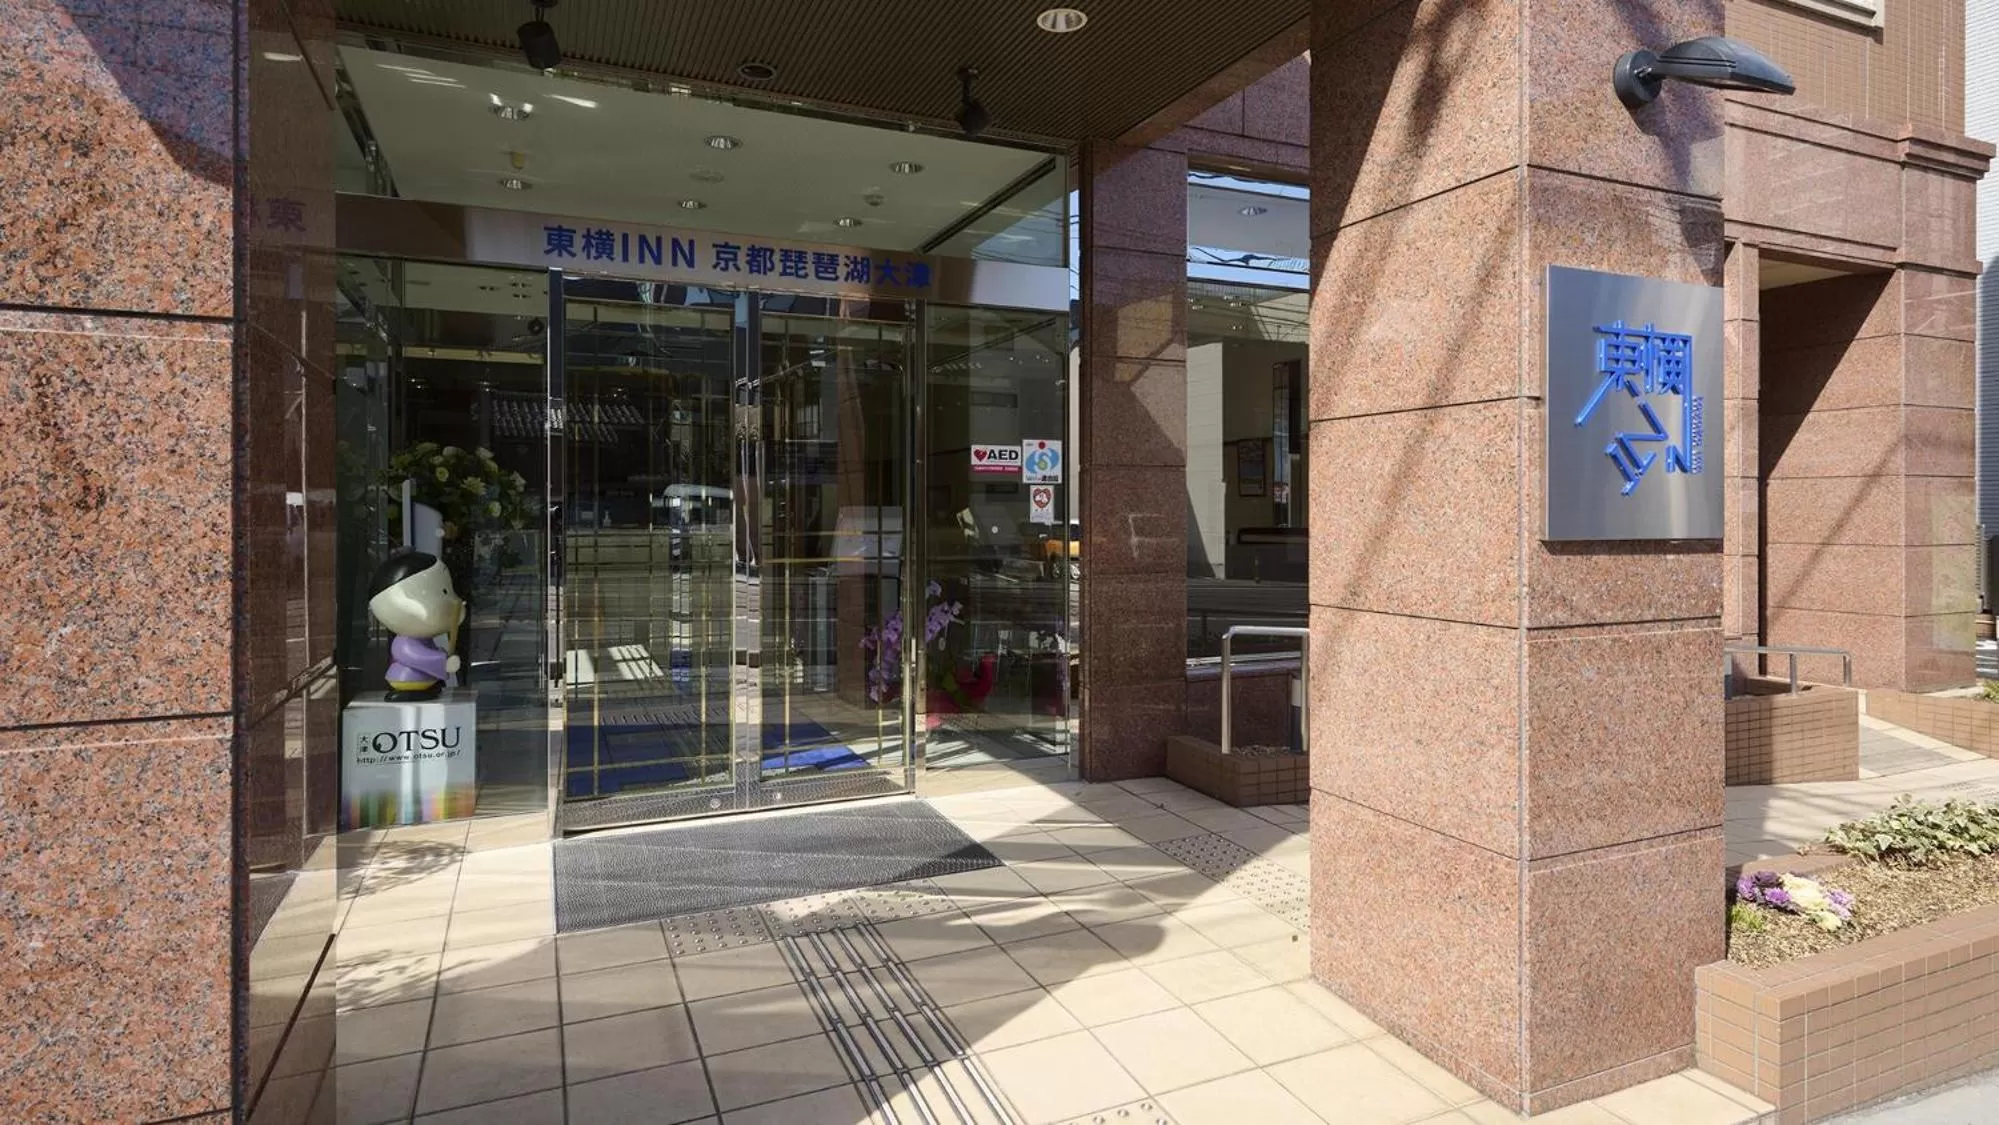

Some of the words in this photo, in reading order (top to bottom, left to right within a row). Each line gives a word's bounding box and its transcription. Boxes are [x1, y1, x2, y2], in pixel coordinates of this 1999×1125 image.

[543, 225, 696, 269] 東横INN
[987, 449, 1019, 460] AED
[372, 727, 461, 753] OTSU
